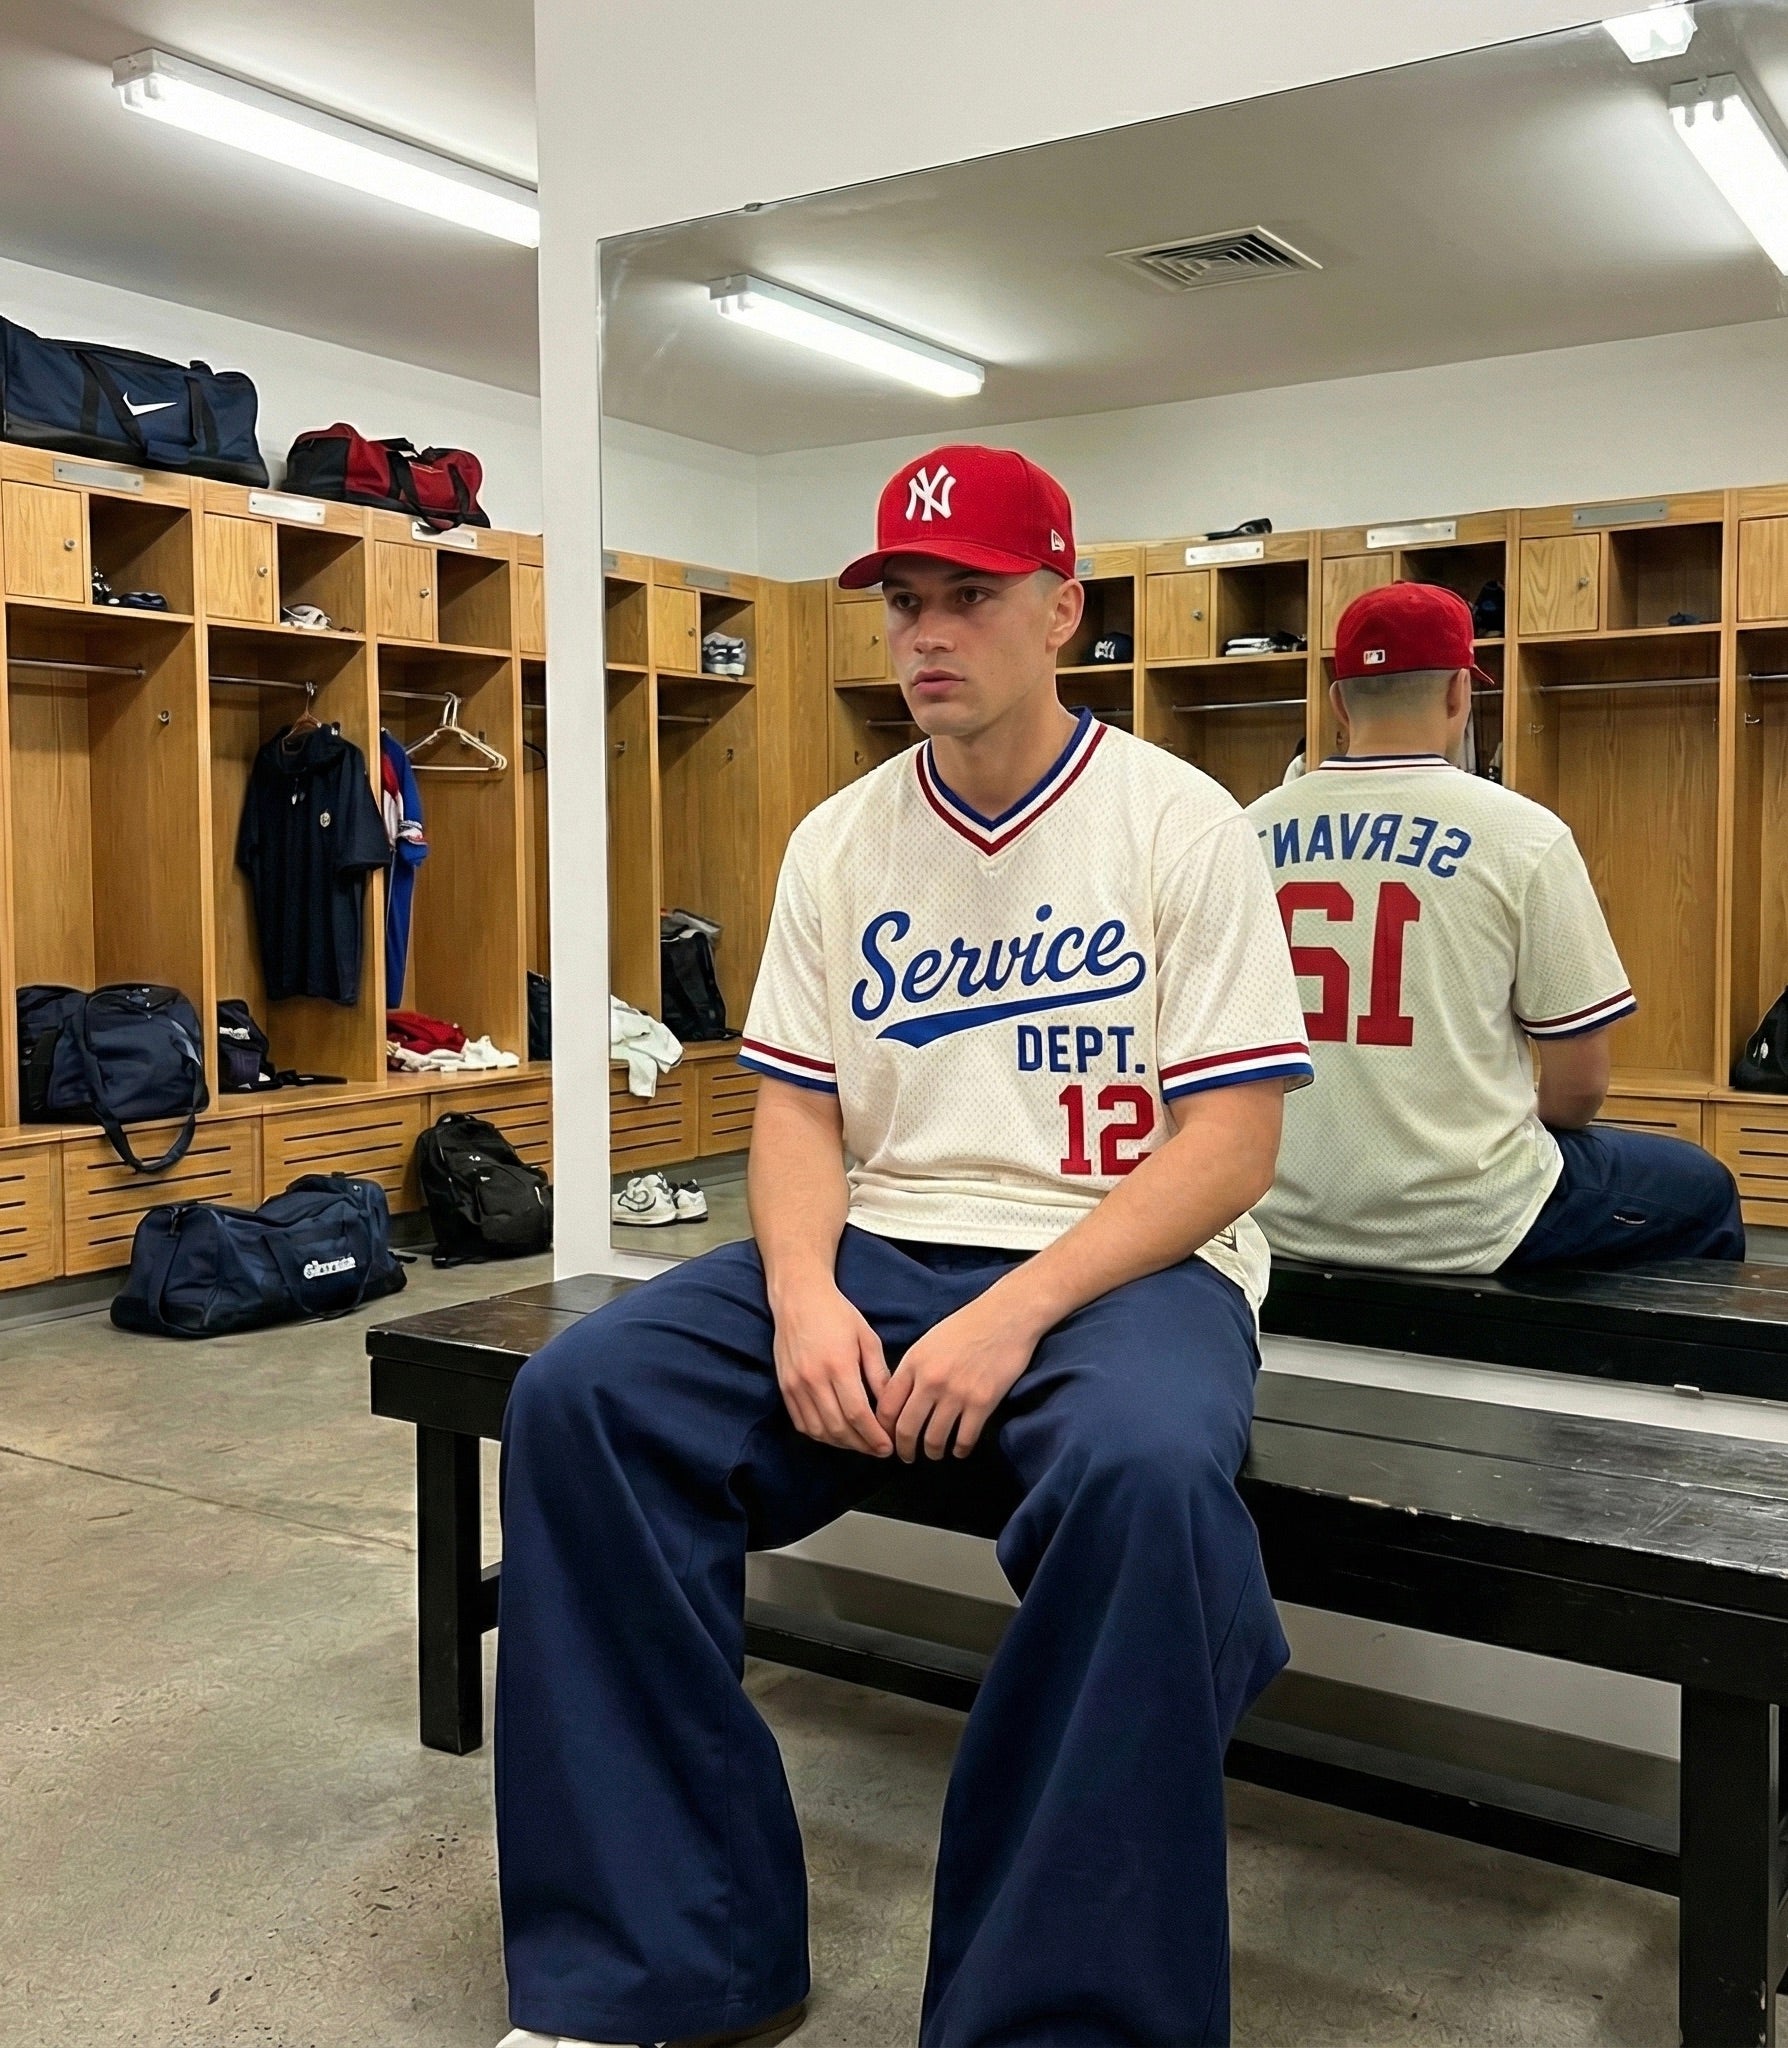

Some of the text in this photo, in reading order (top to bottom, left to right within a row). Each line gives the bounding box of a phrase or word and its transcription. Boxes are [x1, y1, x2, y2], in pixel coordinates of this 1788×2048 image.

[905, 464, 957, 522] NY
[851, 904, 1147, 1023] Service
[1017, 1025, 1146, 1074] DEPT.
[1059, 1084, 1156, 1176] 12
